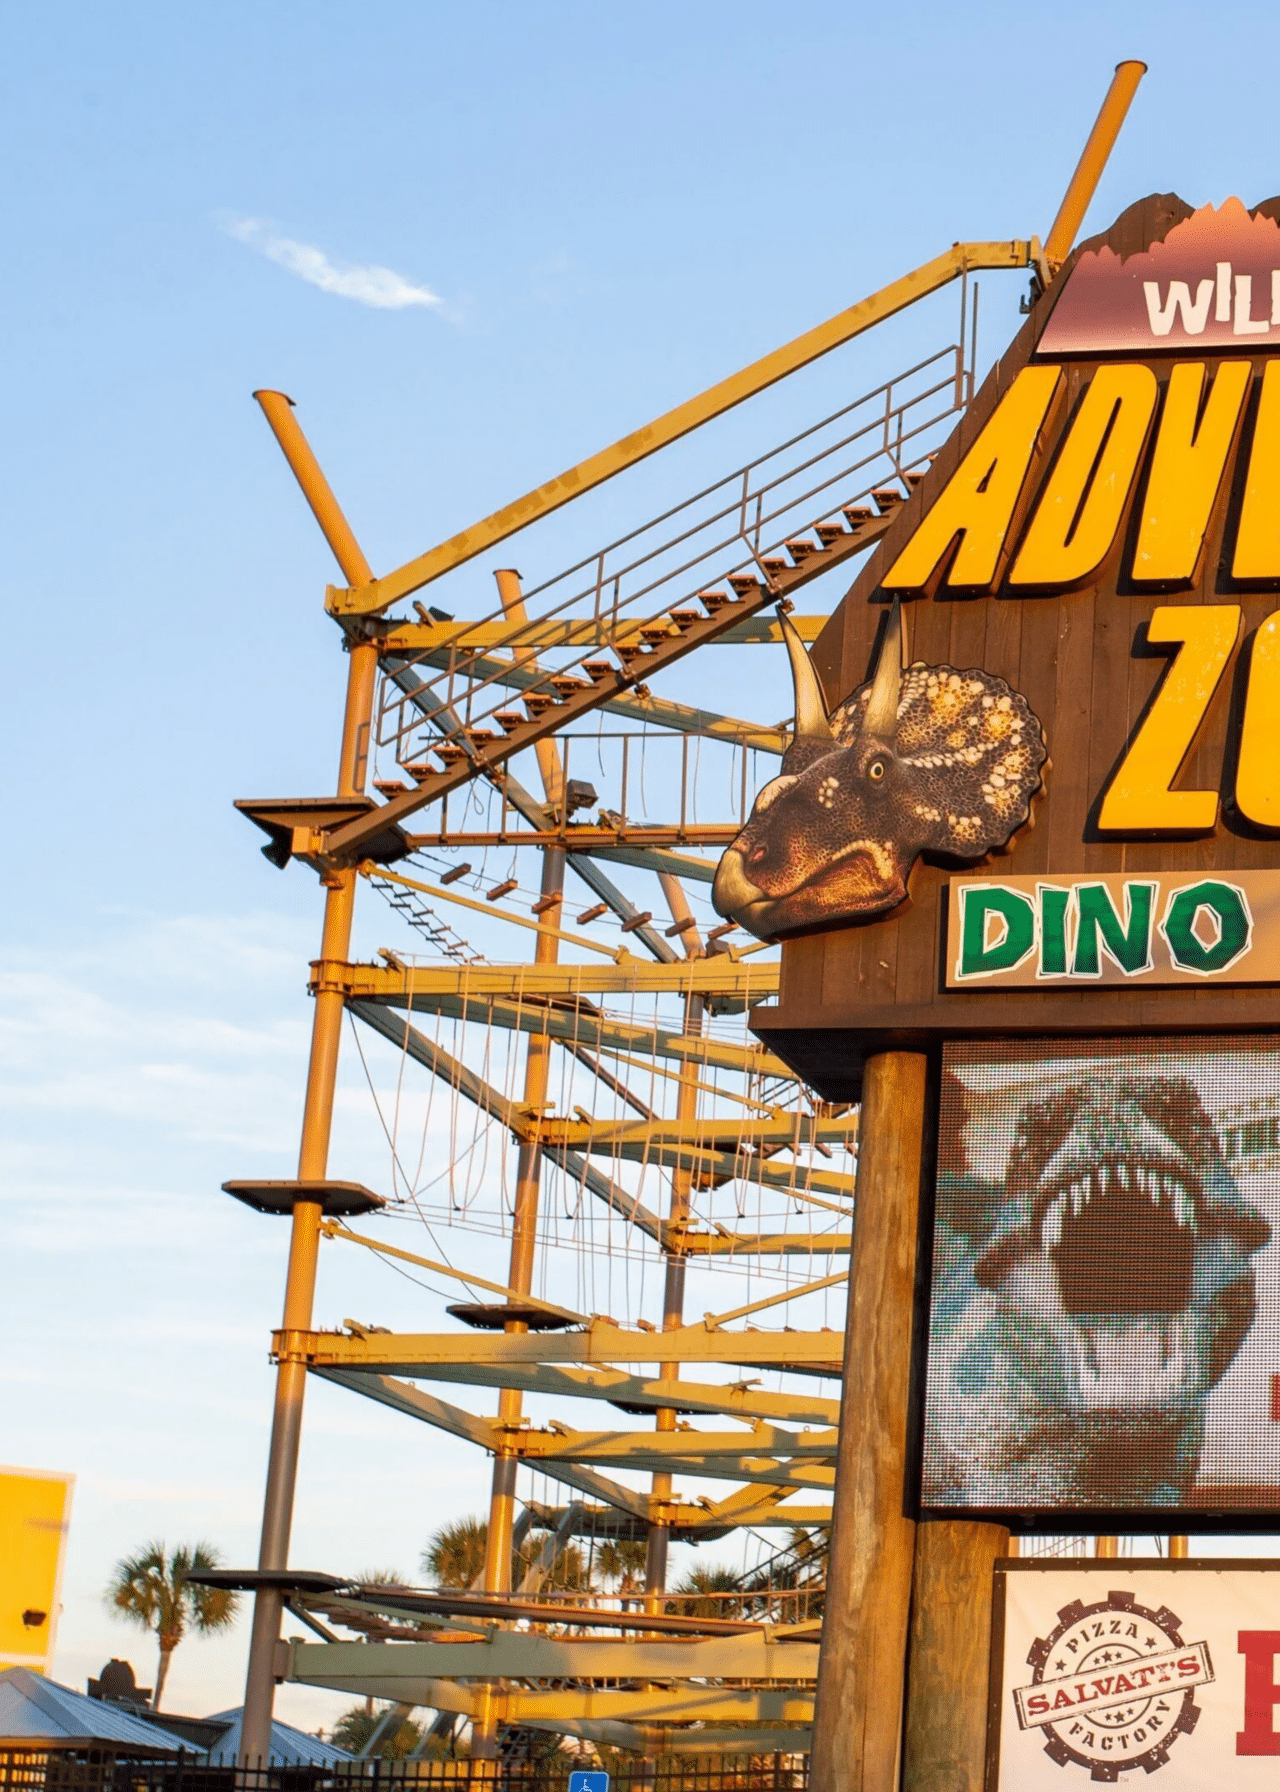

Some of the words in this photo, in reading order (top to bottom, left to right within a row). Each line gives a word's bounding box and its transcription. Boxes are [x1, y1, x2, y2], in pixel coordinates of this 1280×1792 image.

[954, 876, 1254, 981] DINO
[1065, 1619, 1139, 1654] PIZZA
[1026, 1655, 1201, 1717] SALVATI'S
[1068, 1699, 1171, 1751] FACTORY
